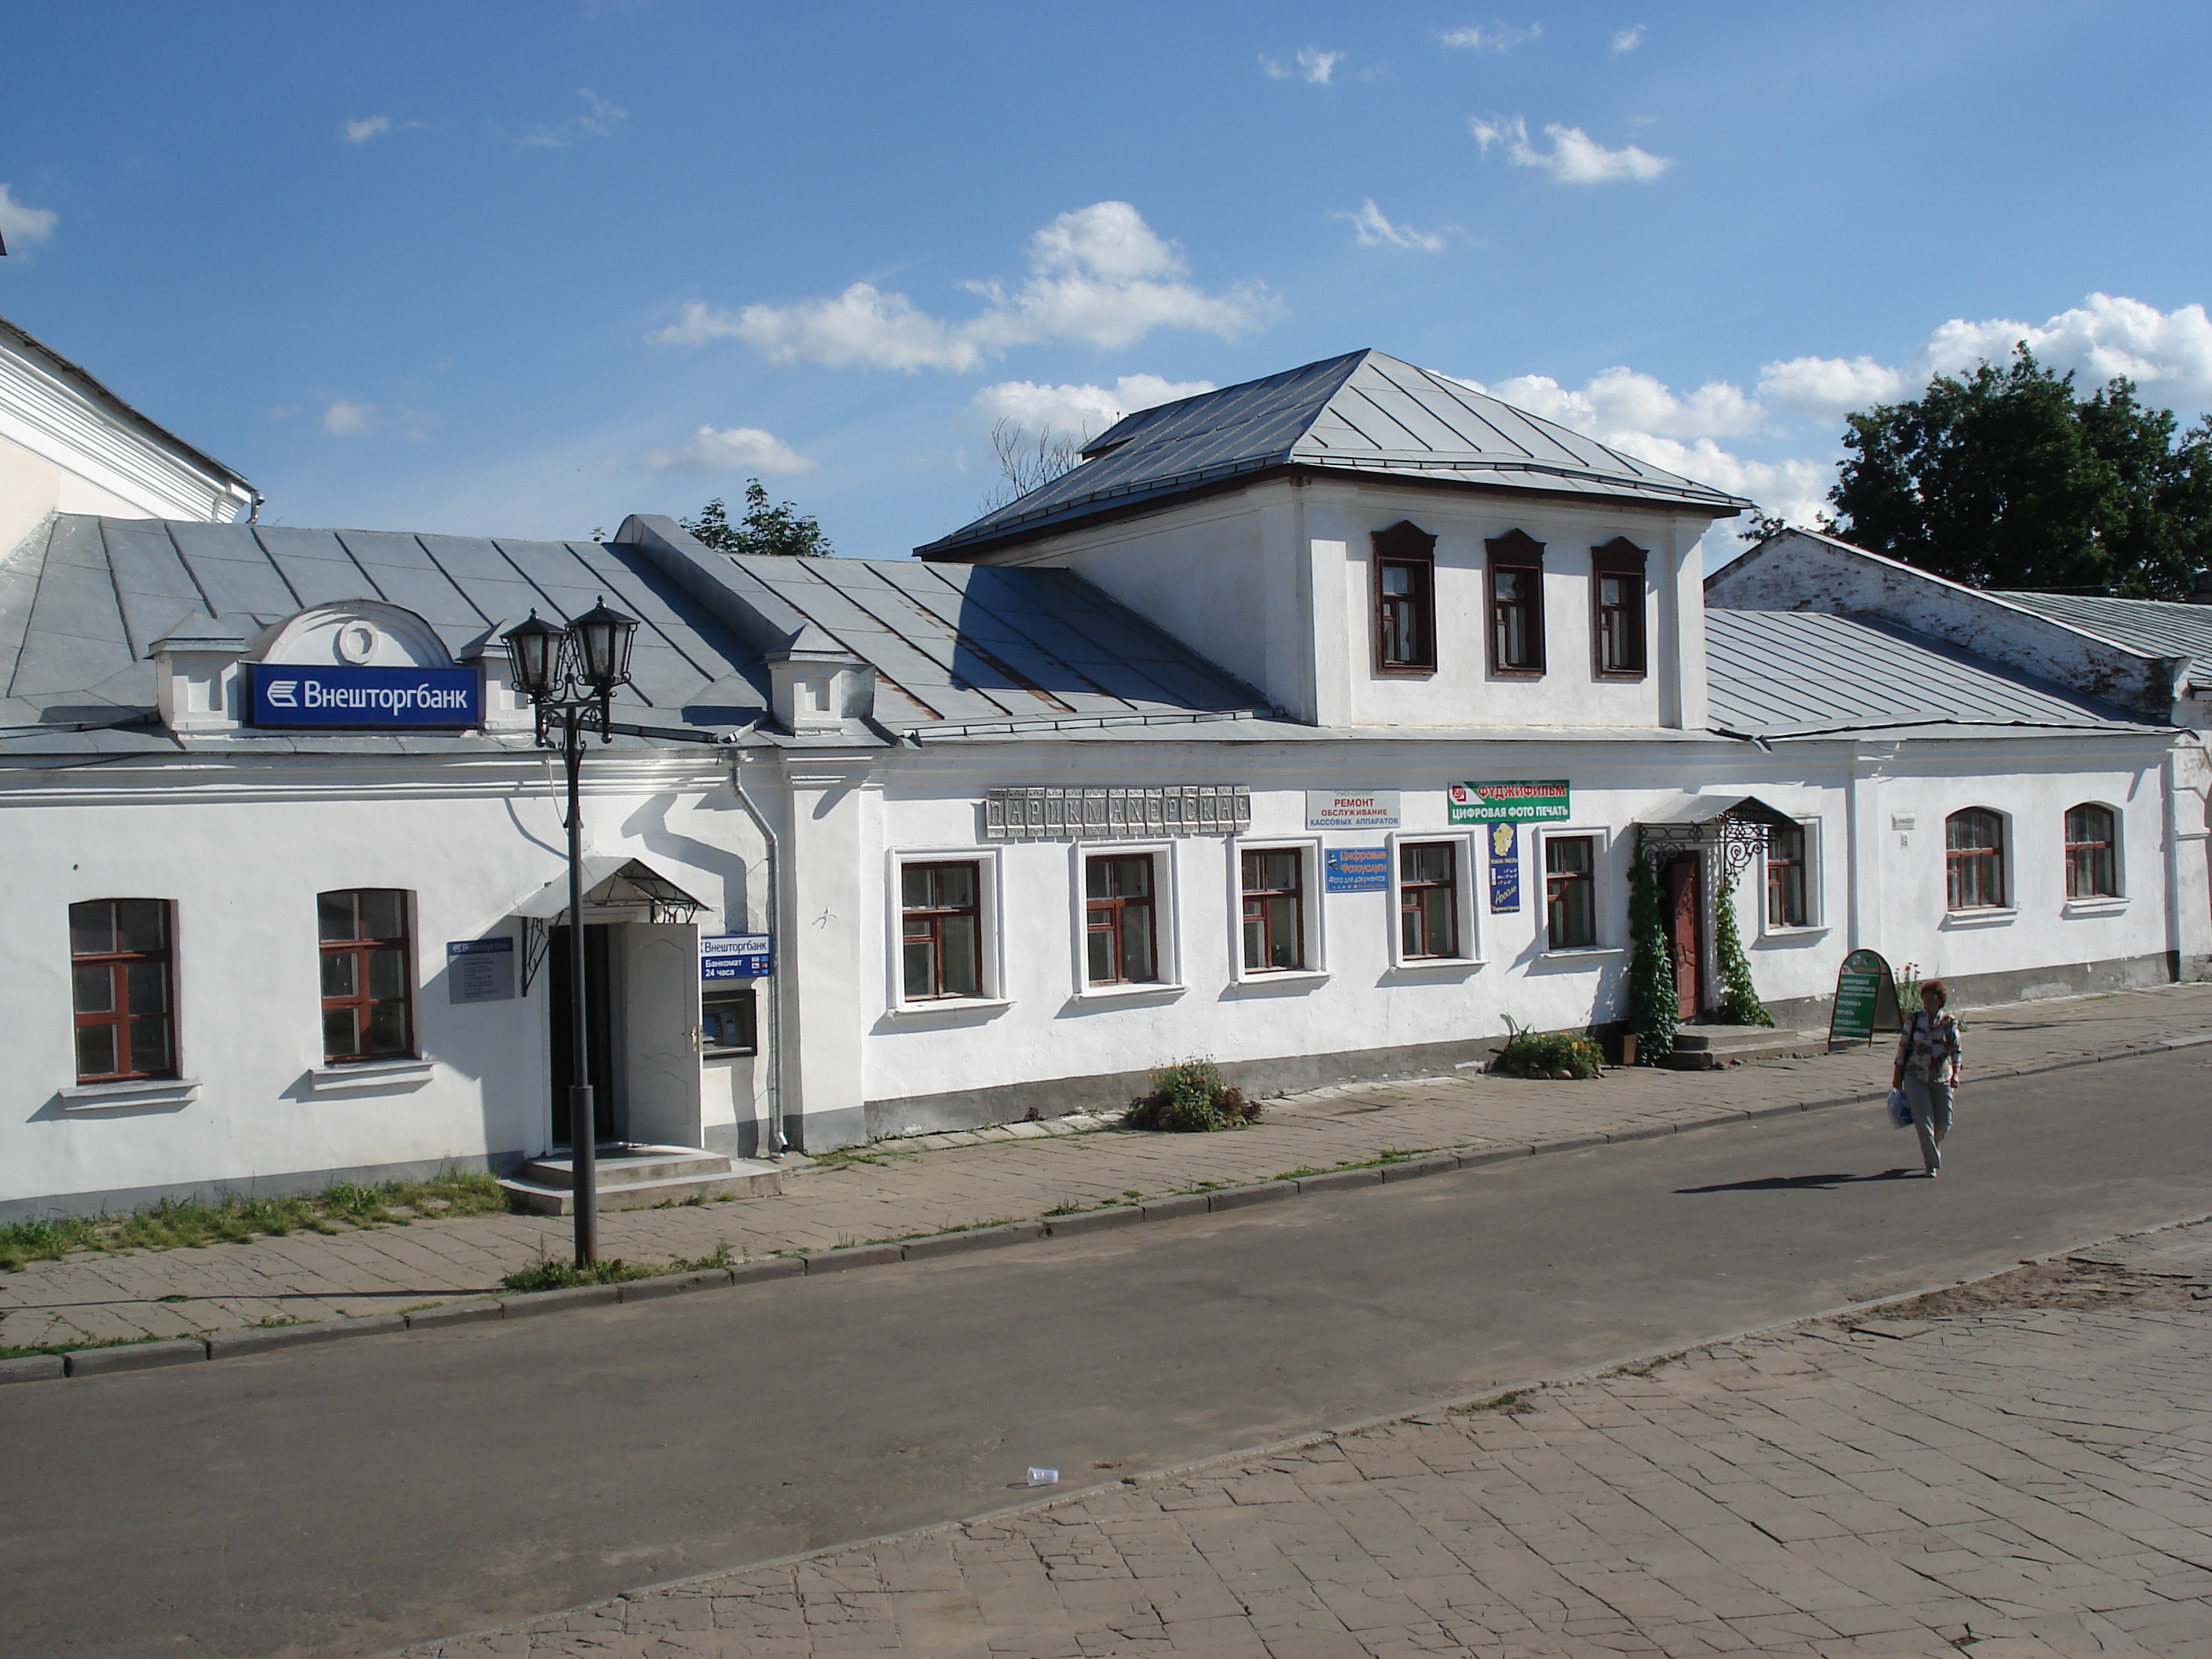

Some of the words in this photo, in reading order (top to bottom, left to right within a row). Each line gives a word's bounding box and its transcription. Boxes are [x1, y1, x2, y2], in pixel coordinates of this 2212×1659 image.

[304, 680, 467, 716] Внешторгбанк
[1478, 784, 1566, 800] ФУДЖИФИЛЬМ
[990, 797, 1247, 825] ПАРИКМАХЕРСКАЯ
[1452, 808, 1507, 820] ЦИФРОВАЯ
[1507, 807, 1534, 817] ФОТО
[1536, 806, 1569, 816] ПЕЧАТЬ
[705, 940, 767, 954] Внешторгбанк
[705, 959, 742, 968] Банкомат
[705, 969, 715, 977] 24
